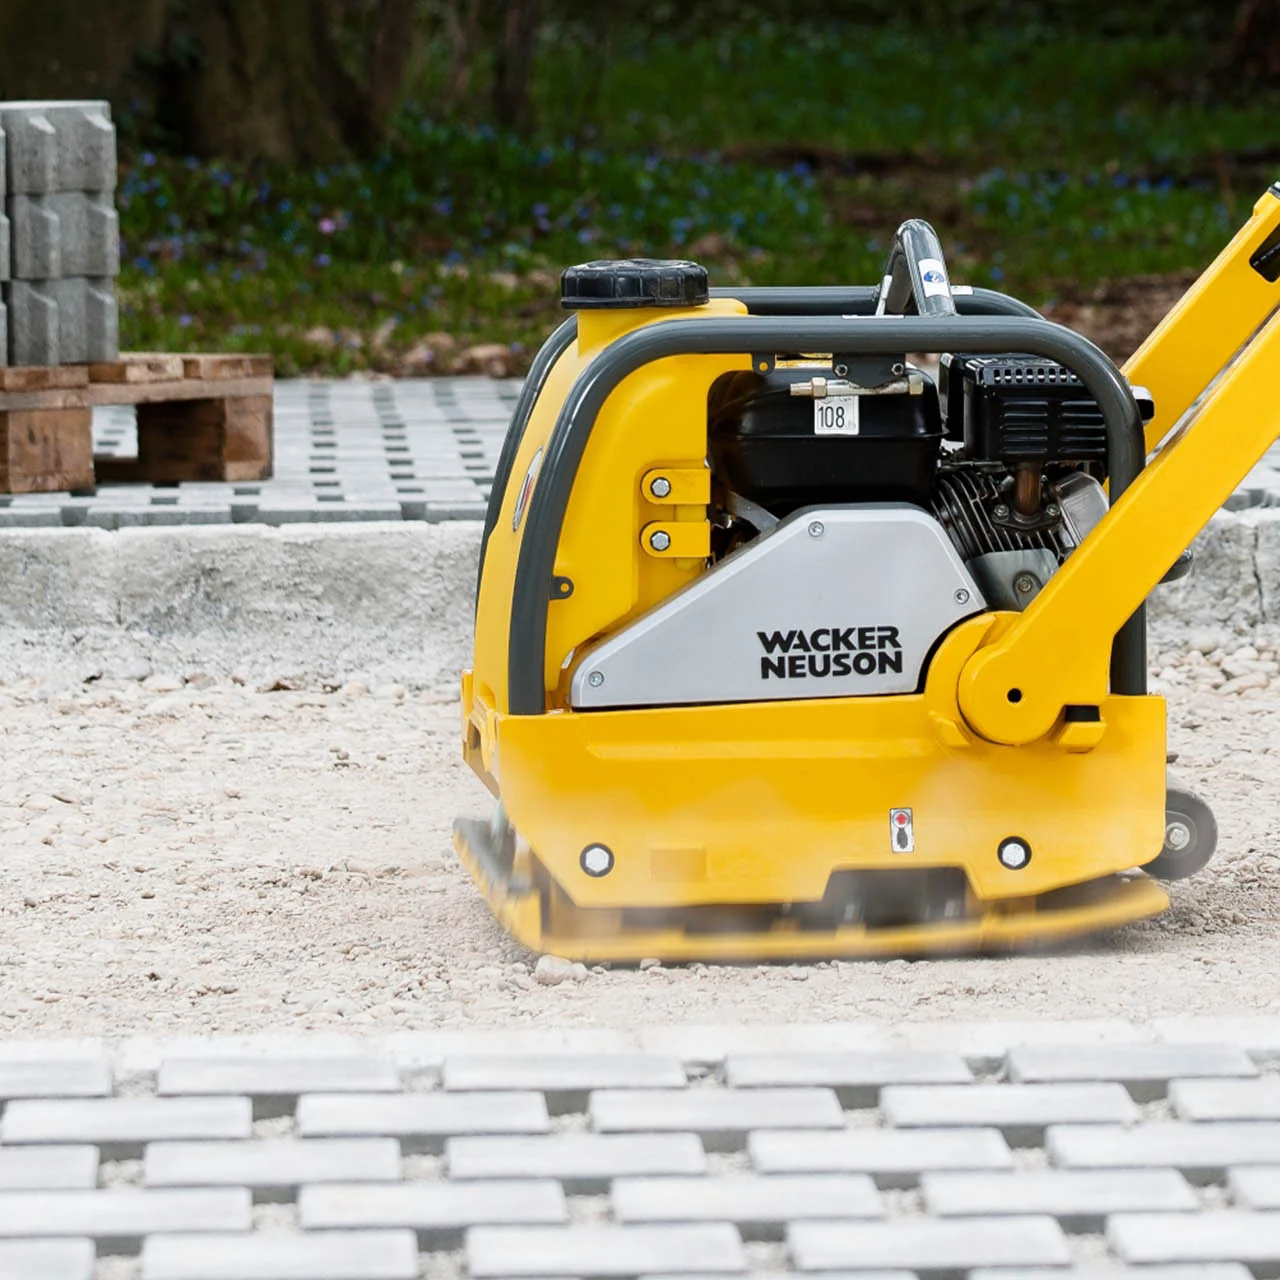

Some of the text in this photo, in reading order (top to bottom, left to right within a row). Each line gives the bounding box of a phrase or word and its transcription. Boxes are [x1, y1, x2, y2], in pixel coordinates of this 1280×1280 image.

[818, 406, 845, 428] 108
[756, 626, 902, 654] WACKER
[760, 651, 903, 679] NEUSON
